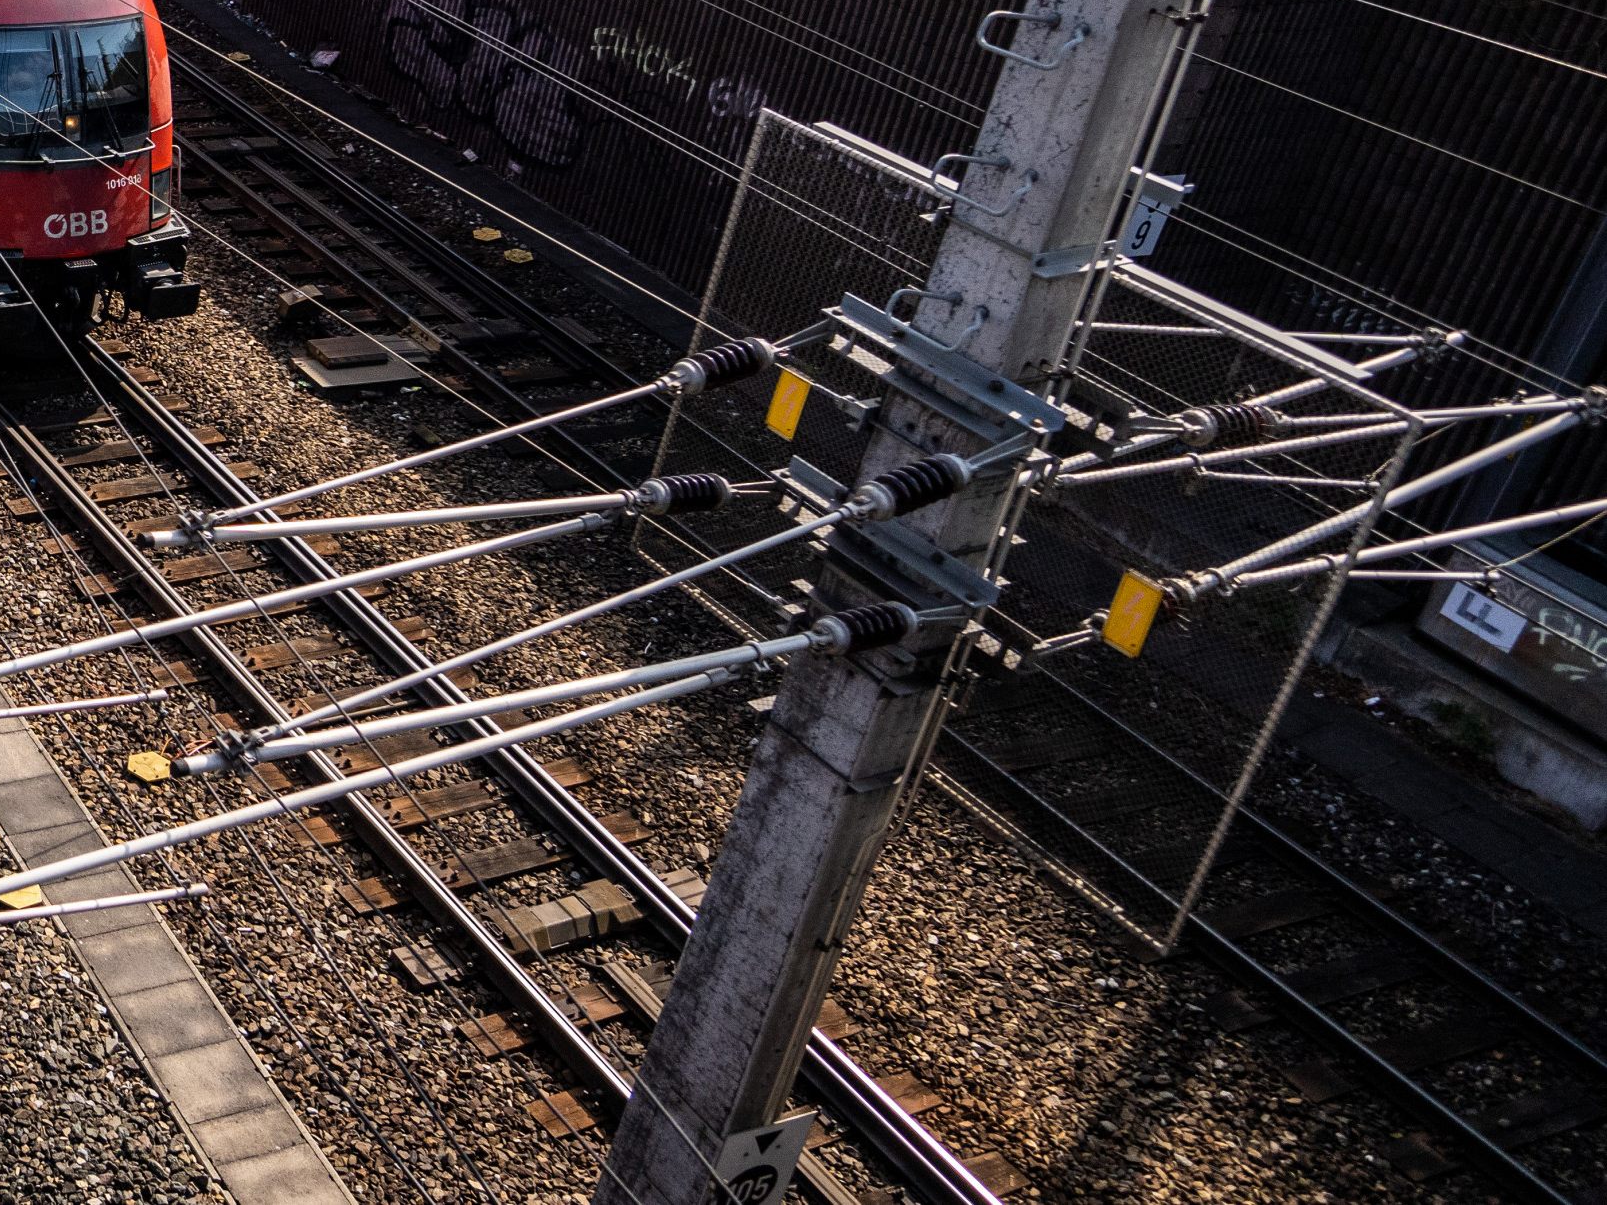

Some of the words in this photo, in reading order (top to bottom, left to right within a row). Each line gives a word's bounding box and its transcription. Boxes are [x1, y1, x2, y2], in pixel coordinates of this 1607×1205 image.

[105, 178, 126, 190] 1016
[43, 209, 108, 238] ÖBB
[1130, 220, 1152, 250] 9
